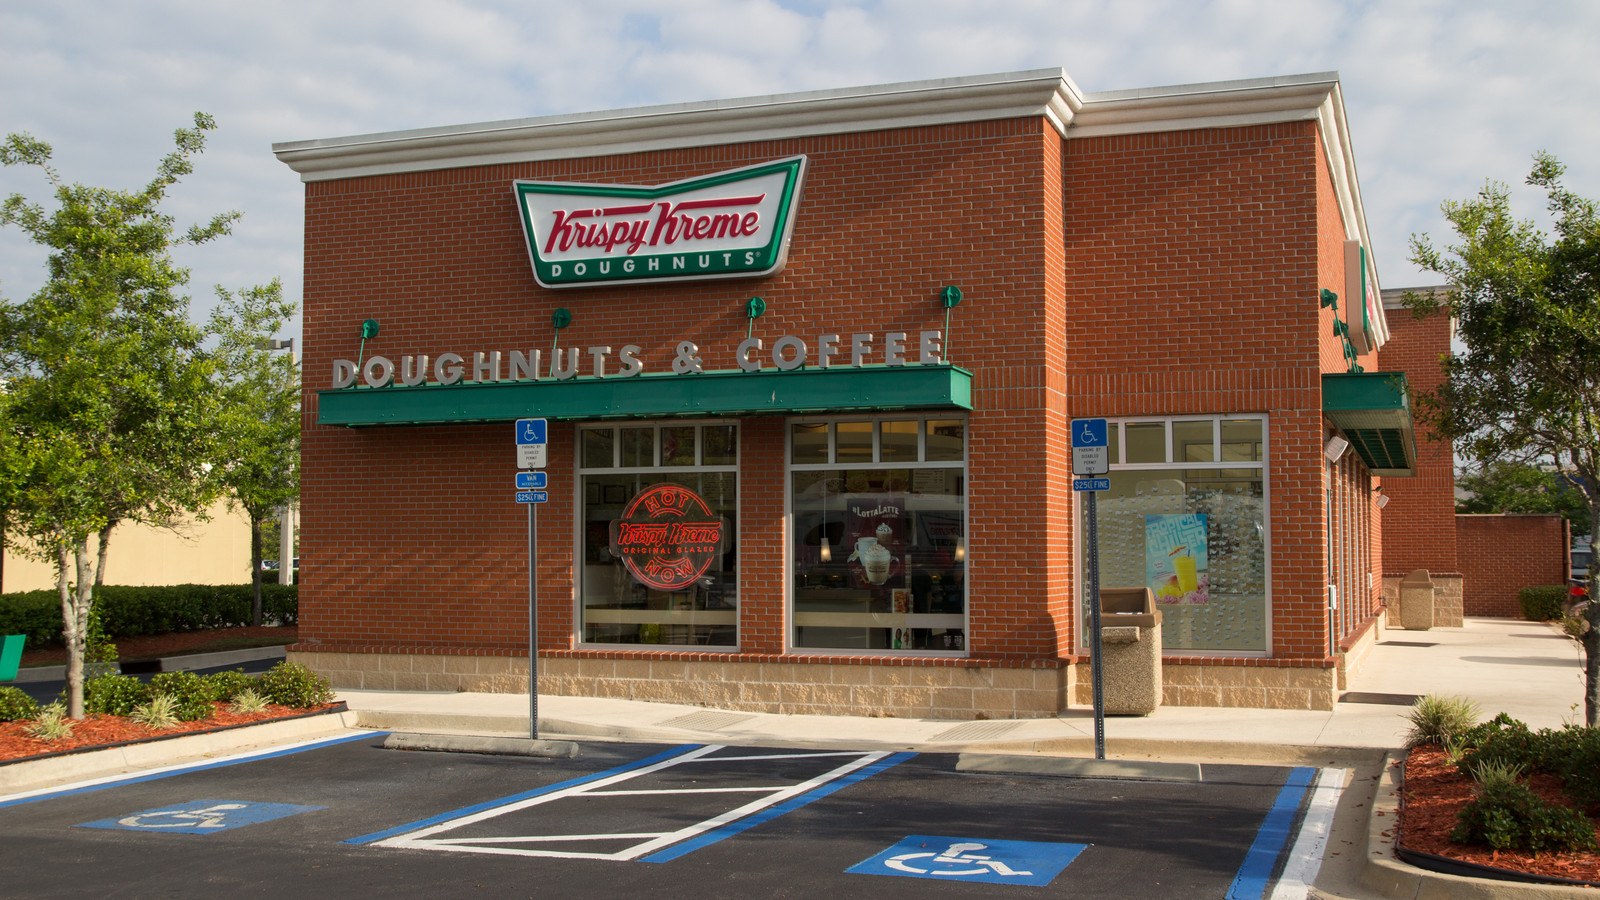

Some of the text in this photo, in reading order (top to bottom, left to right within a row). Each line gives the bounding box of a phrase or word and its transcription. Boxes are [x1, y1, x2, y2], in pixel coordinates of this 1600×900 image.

[544, 193, 766, 255] Krispy Kreme
[332, 331, 942, 389] DOUGHNUTS & COFFEE
[1094, 480, 1108, 489] FINE
[645, 491, 689, 513] HOT
[618, 522, 722, 547] Krispy Kreme
[1145, 514, 1202, 538] TROPICAL
[1149, 526, 1207, 556] CHILLER
[645, 558, 694, 583] NOW
